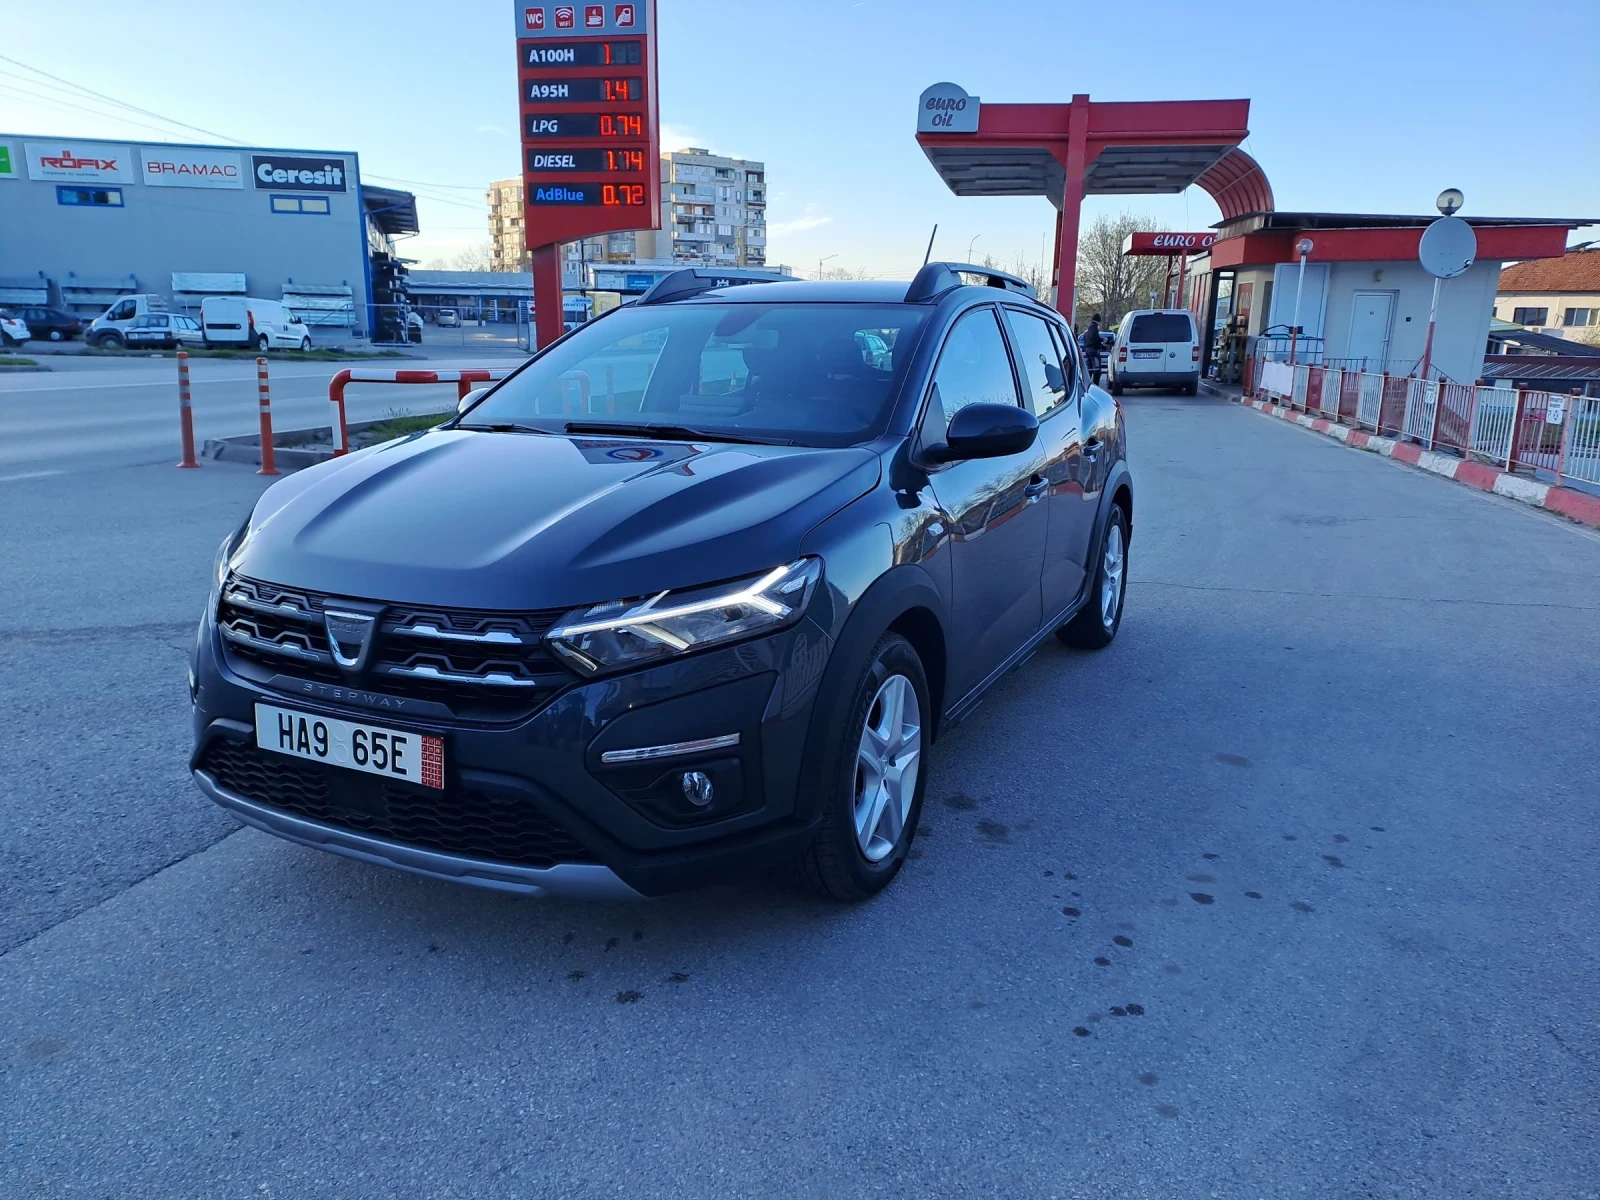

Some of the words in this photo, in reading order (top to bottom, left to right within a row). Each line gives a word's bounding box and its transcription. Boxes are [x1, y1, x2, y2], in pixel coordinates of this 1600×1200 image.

[526, 13, 543, 24] WC
[528, 49, 574, 63] A100H
[530, 84, 569, 98] A95H
[925, 97, 967, 111] EURO
[532, 120, 558, 133] LPG
[600, 115, 641, 136] 0.74
[147, 161, 238, 177] BRAMAC
[534, 155, 576, 168] DIESEL
[257, 163, 343, 185] Ceresit
[536, 187, 584, 201] AdBlue
[602, 185, 644, 205] 0.72
[1153, 234, 1196, 247] EURO
[303, 683, 406, 708] STEPWAY
[278, 712, 329, 758] HA9
[352, 728, 408, 776] 65E
